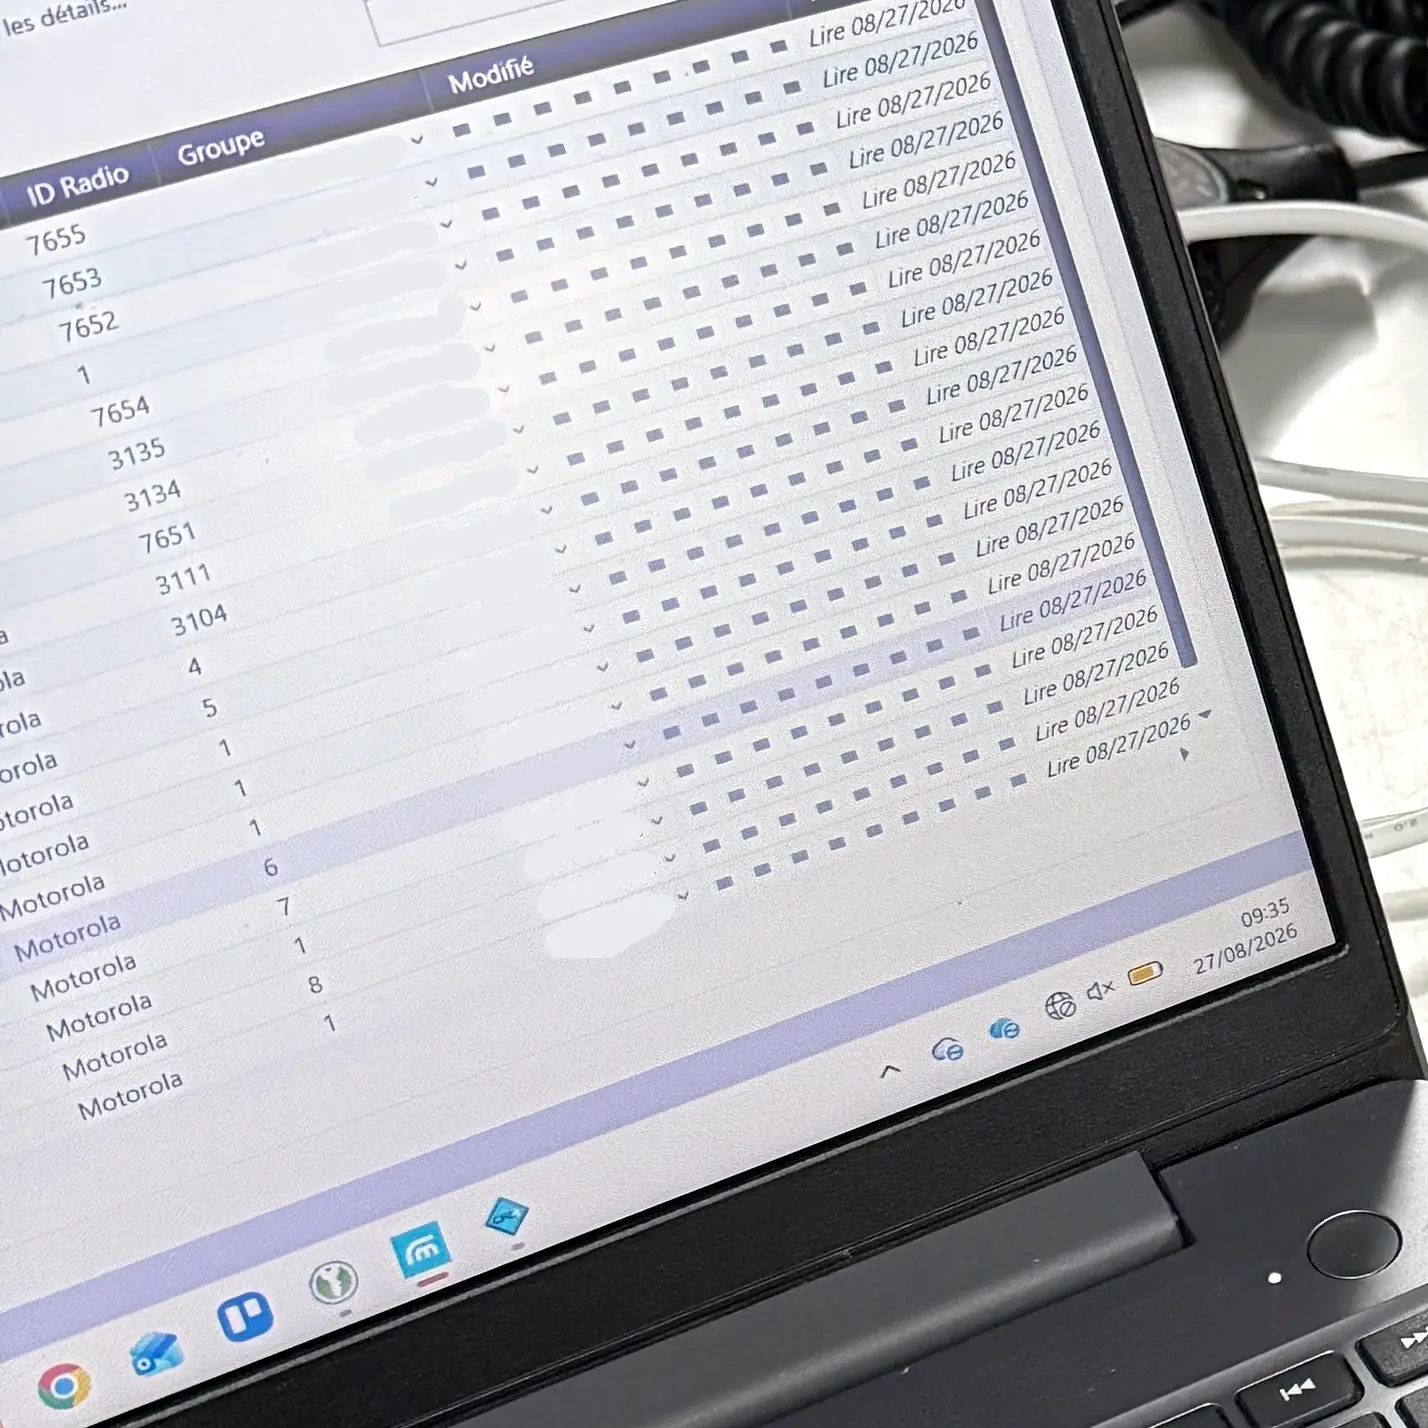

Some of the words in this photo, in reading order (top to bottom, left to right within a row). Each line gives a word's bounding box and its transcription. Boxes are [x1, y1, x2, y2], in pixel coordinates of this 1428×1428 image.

[2, 15, 35, 37] les
[810, 15, 845, 48] Lire
[448, 53, 535, 95] Modifié
[823, 57, 858, 89] Lire
[865, 30, 978, 77] 08/27/2026
[836, 97, 872, 129] Lire
[878, 71, 991, 118] 08/27/2026
[178, 128, 266, 166] Groupe
[849, 137, 885, 170] Lire
[891, 111, 1004, 158] 08/27/2026
[27, 184, 55, 208] ID
[62, 167, 130, 199] Radio
[863, 178, 897, 210] Lire
[904, 151, 1016, 197] 08/27/2026
[25, 224, 86, 256] 7655
[876, 217, 910, 249] Lire
[916, 190, 1029, 237] 08/27/2026
[889, 257, 923, 289] Lire
[929, 229, 1041, 276] 08/27/2026
[42, 267, 102, 300] 7653
[902, 297, 936, 328] Lire
[942, 268, 1053, 316] 08/27/2026
[59, 311, 119, 343] 7652
[914, 337, 948, 367] Lire
[955, 306, 1065, 354] 08/27/2026
[77, 365, 91, 385] 1
[927, 375, 960, 405] Lire
[967, 344, 1078, 392] 08/27/2026
[91, 395, 150, 427] 7654
[940, 413, 973, 444] Lire
[979, 382, 1089, 430] 08/27/2026
[108, 438, 166, 470] 3135
[952, 451, 985, 482] Lire
[992, 420, 1101, 468] 08/27/2026
[124, 479, 181, 512] 3134
[964, 490, 998, 520] Lire
[1004, 458, 1113, 507] 08/27/2026
[139, 522, 196, 554] 7651
[976, 527, 1009, 558] Lire
[1016, 495, 1124, 543] 08/27/2026
[156, 563, 211, 595] 3111
[988, 565, 1022, 595] Lire
[1028, 532, 1136, 581] 08/27/2026
[172, 604, 228, 636] 3104
[1000, 602, 1033, 631] Lire
[1039, 568, 1147, 618] 08/27/2026
[1012, 639, 1045, 669] Lire
[1051, 605, 1158, 654] 08/27/2026
[188, 657, 202, 676] 4
[1024, 675, 1057, 705] Lire
[1063, 641, 1170, 691] 08/27/2026
[0, 712, 42, 738] rola
[203, 699, 217, 718] 5
[1036, 713, 1069, 742] Lire
[1075, 677, 1181, 728] 08/27/2026
[219, 738, 232, 757] 1
[1048, 748, 1080, 778] Lire
[1086, 713, 1191, 763] 08/27/2026
[0, 753, 58, 784] orola
[234, 779, 248, 798] 1
[0, 794, 74, 831] torola
[249, 818, 262, 837] 1
[0, 835, 90, 876] otorola
[264, 858, 278, 876] 6
[0, 874, 105, 922] Motorola
[277, 897, 291, 916] 7
[1241, 897, 1290, 928] 09:35
[14, 913, 122, 963] Motorola
[294, 936, 307, 954] 1
[1193, 924, 1298, 975] 27/08/2026
[30, 952, 137, 1002] Motorola
[309, 976, 323, 993] 8
[46, 993, 153, 1042] Motorola
[324, 1014, 337, 1032] 1
[62, 1032, 168, 1081] Motorola
[78, 1071, 184, 1121] Motorola
